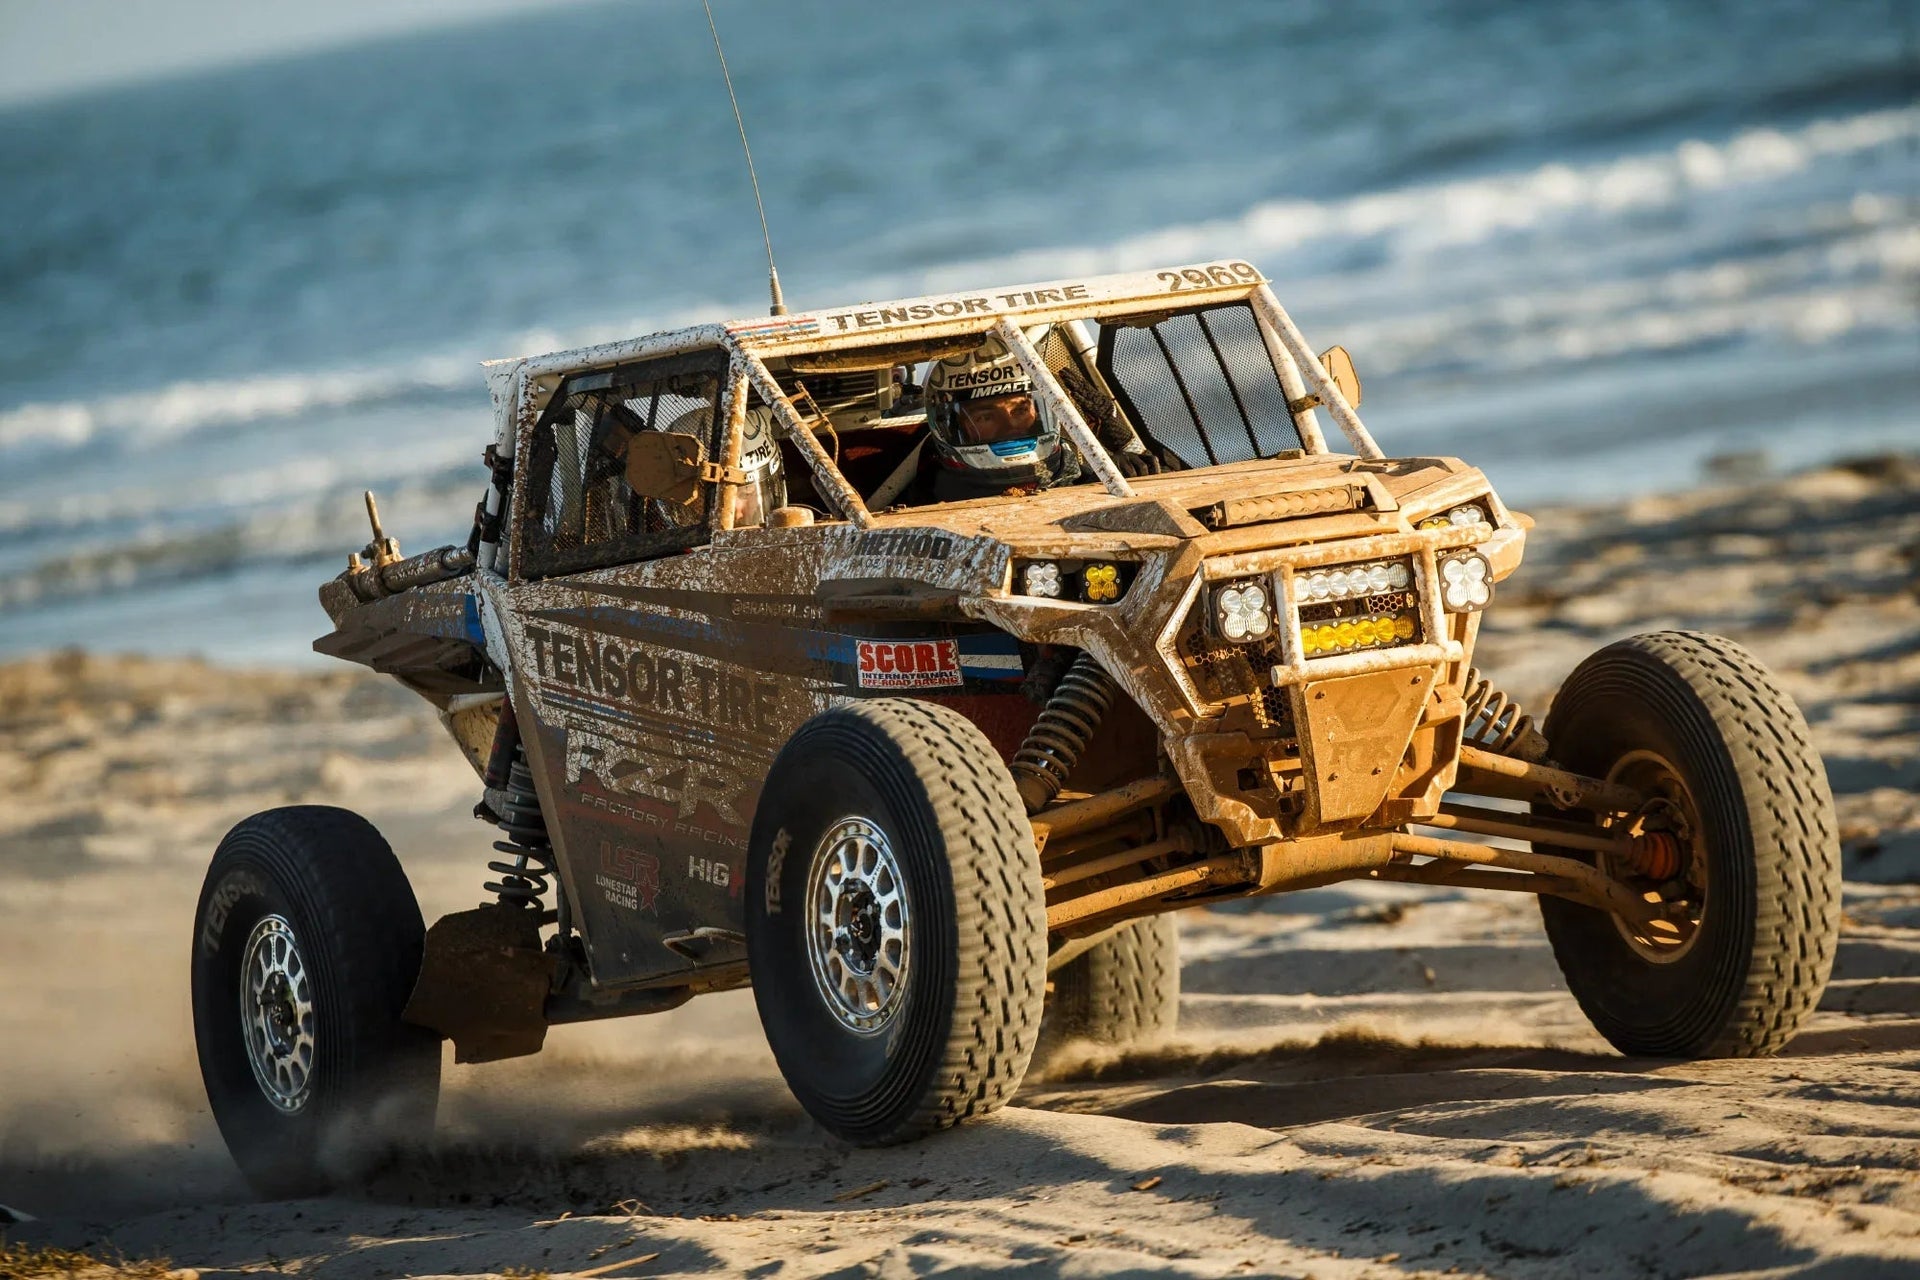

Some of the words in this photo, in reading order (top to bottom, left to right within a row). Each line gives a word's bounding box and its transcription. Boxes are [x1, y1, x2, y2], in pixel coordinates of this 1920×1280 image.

[1157, 262, 1261, 292] 2969
[826, 297, 992, 331] TENSOR
[996, 285, 1088, 307] TIRE
[948, 365, 1015, 388] TENSOR
[970, 380, 1032, 399] IMPACT
[745, 440, 771, 464] TIRE
[855, 533, 952, 560] METHOD
[861, 642, 956, 673] SCORE
[526, 625, 686, 713] TENSOR
[691, 666, 780, 739] TIRE
[862, 671, 958, 680] INTERNATIONAL
[862, 679, 911, 687] OFF-ROAD
[565, 727, 748, 827] RZR
[581, 793, 669, 831] FACTORY
[674, 822, 750, 851] RACING
[688, 855, 730, 888] HIG
[595, 873, 638, 898] LONESTAR
[605, 889, 638, 910] RACING
